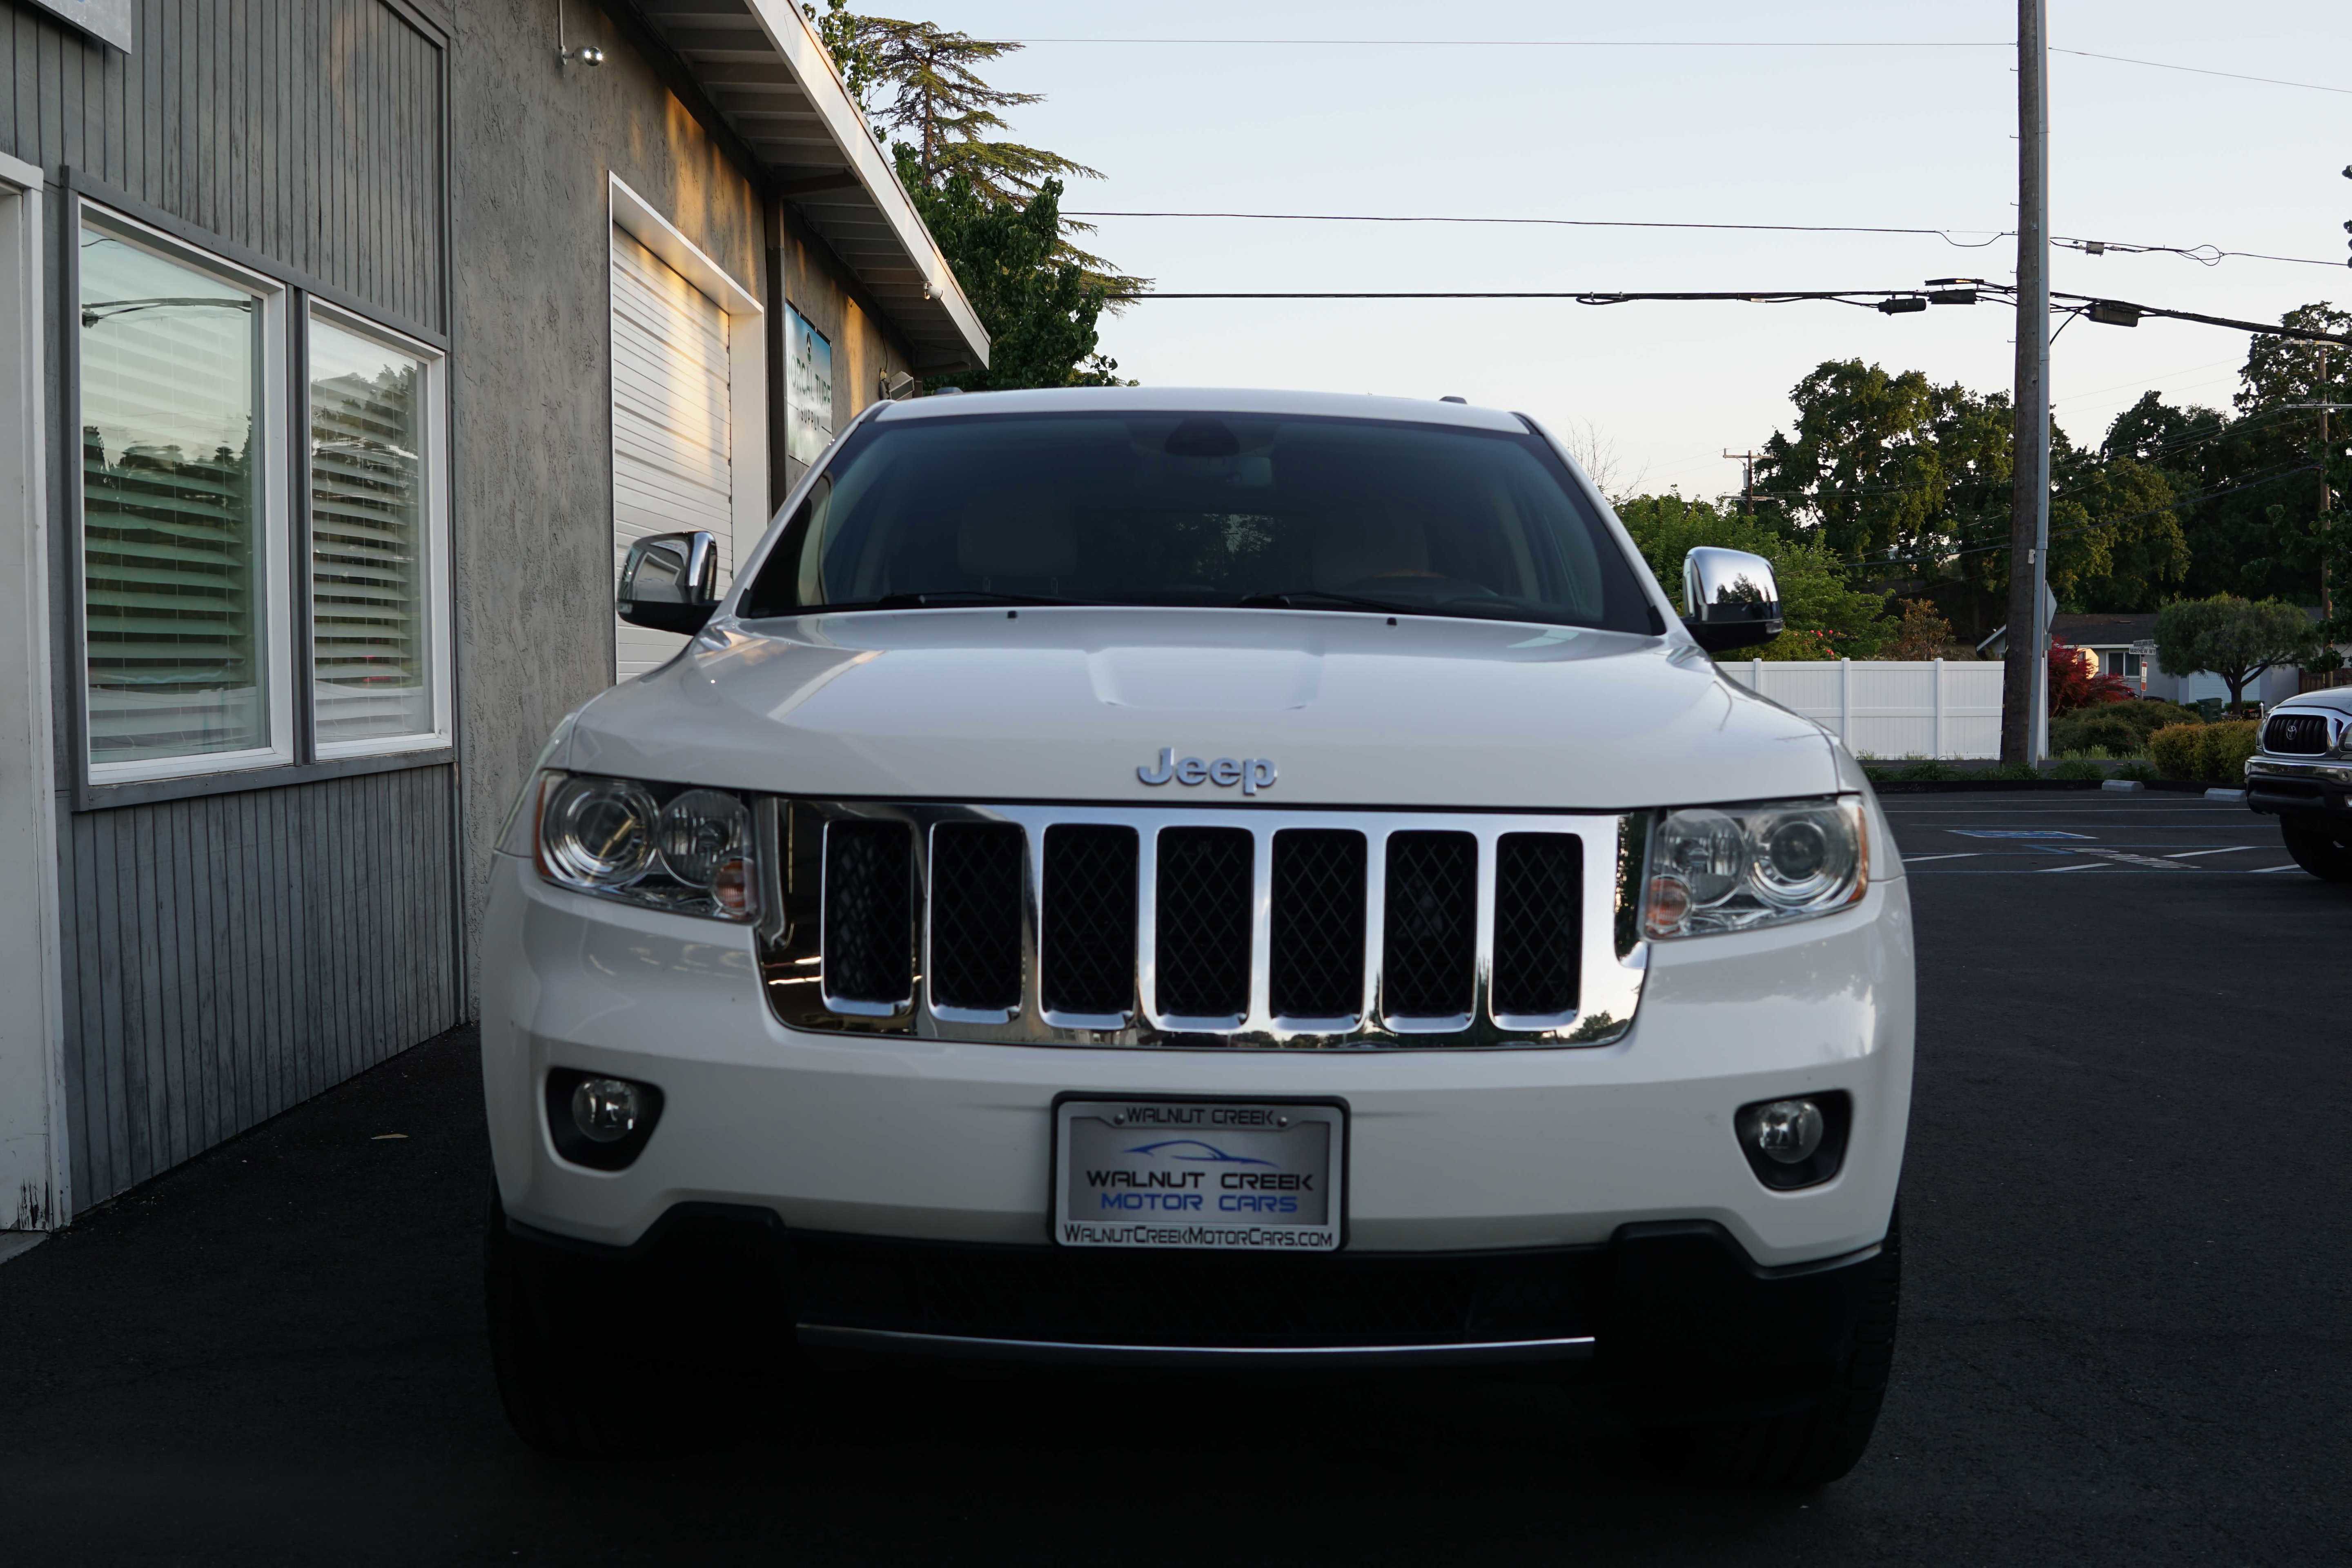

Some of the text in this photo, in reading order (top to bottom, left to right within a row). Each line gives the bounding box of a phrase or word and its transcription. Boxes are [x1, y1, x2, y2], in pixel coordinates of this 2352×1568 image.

[815, 373, 831, 414] TURF
[800, 403, 820, 433] SUPPLY
[1137, 748, 1277, 796] Jeep
[1126, 1107, 1274, 1126] WALNUT CREEK
[1086, 1171, 1313, 1191] WALNUT CREEK
[1101, 1194, 1298, 1212] MOTOR CARS
